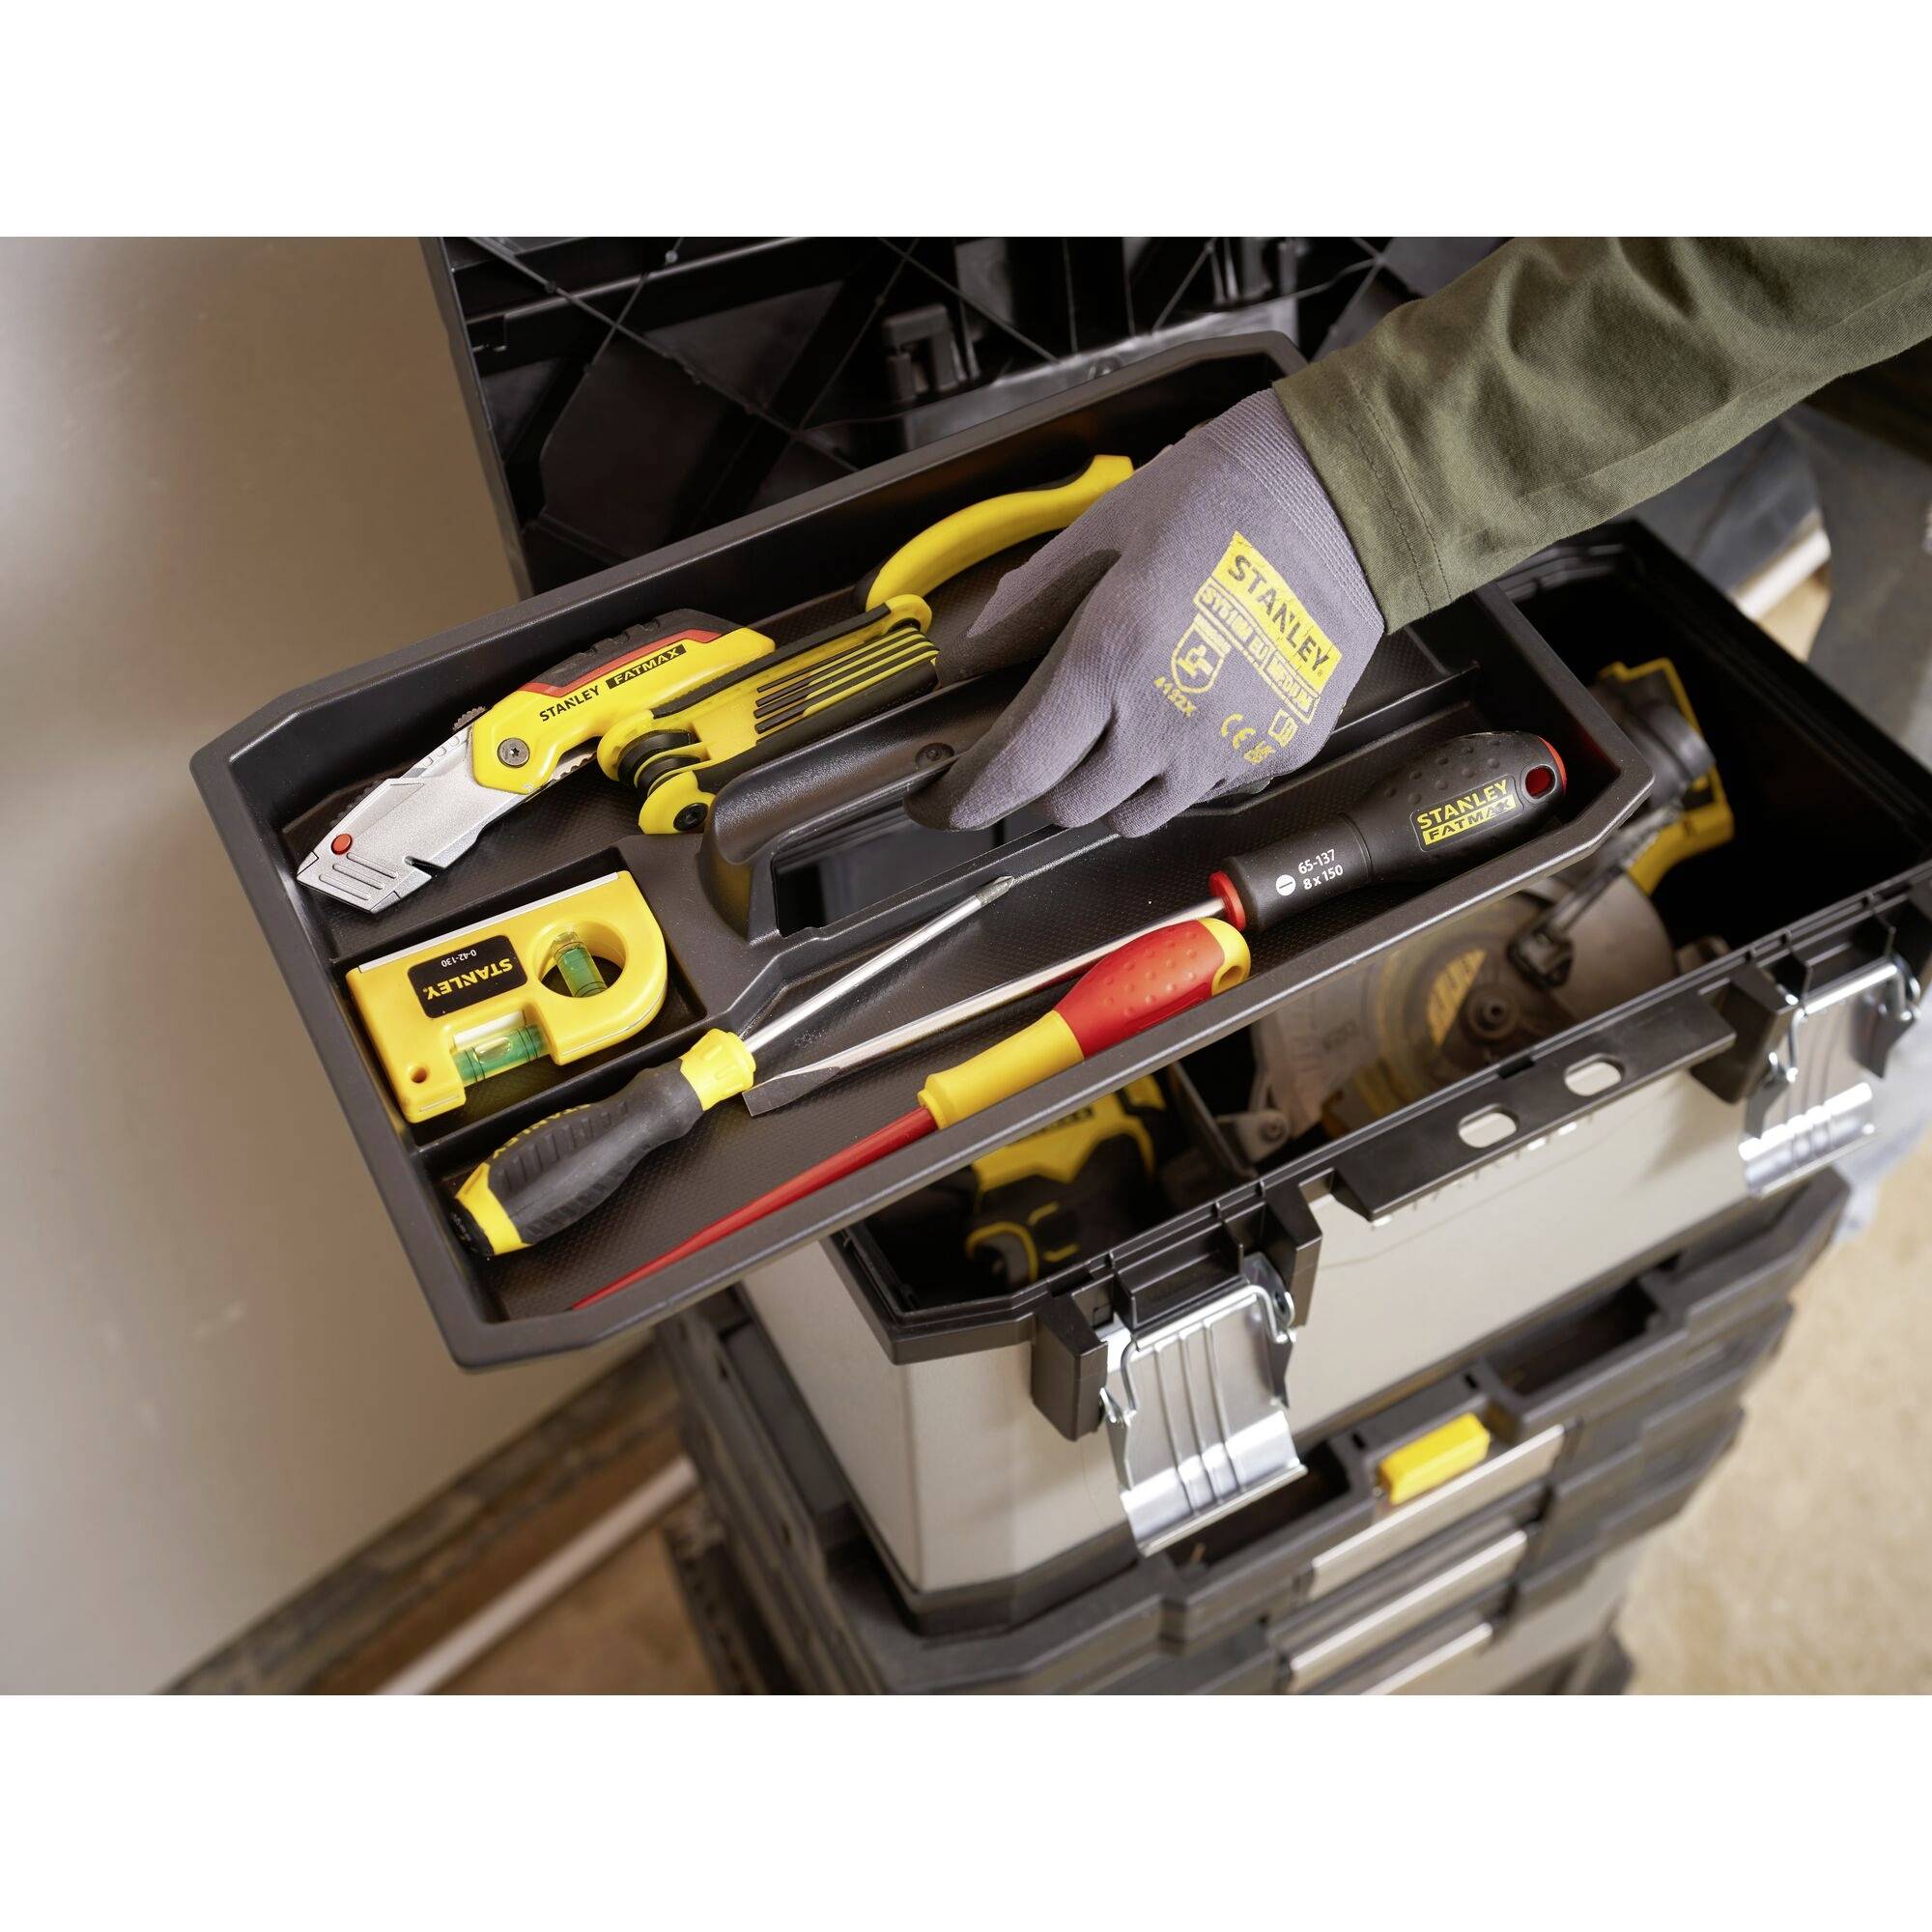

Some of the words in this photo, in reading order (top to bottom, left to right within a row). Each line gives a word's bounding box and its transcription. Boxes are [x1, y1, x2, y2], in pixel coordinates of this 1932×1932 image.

[1228, 554, 1329, 671] STANLEY
[539, 685, 600, 722] STANLEY
[613, 647, 679, 685] FATMAX
[1416, 779, 1508, 830] STANLEY
[1428, 798, 1513, 841] FATMAX
[1298, 848, 1336, 874] 65-137
[1302, 876, 1313, 891] 8
[1313, 876, 1321, 886] x
[1322, 864, 1344, 884] 150
[427, 958, 513, 1000] STANLEY
[440, 949, 477, 967] 0-42-130
